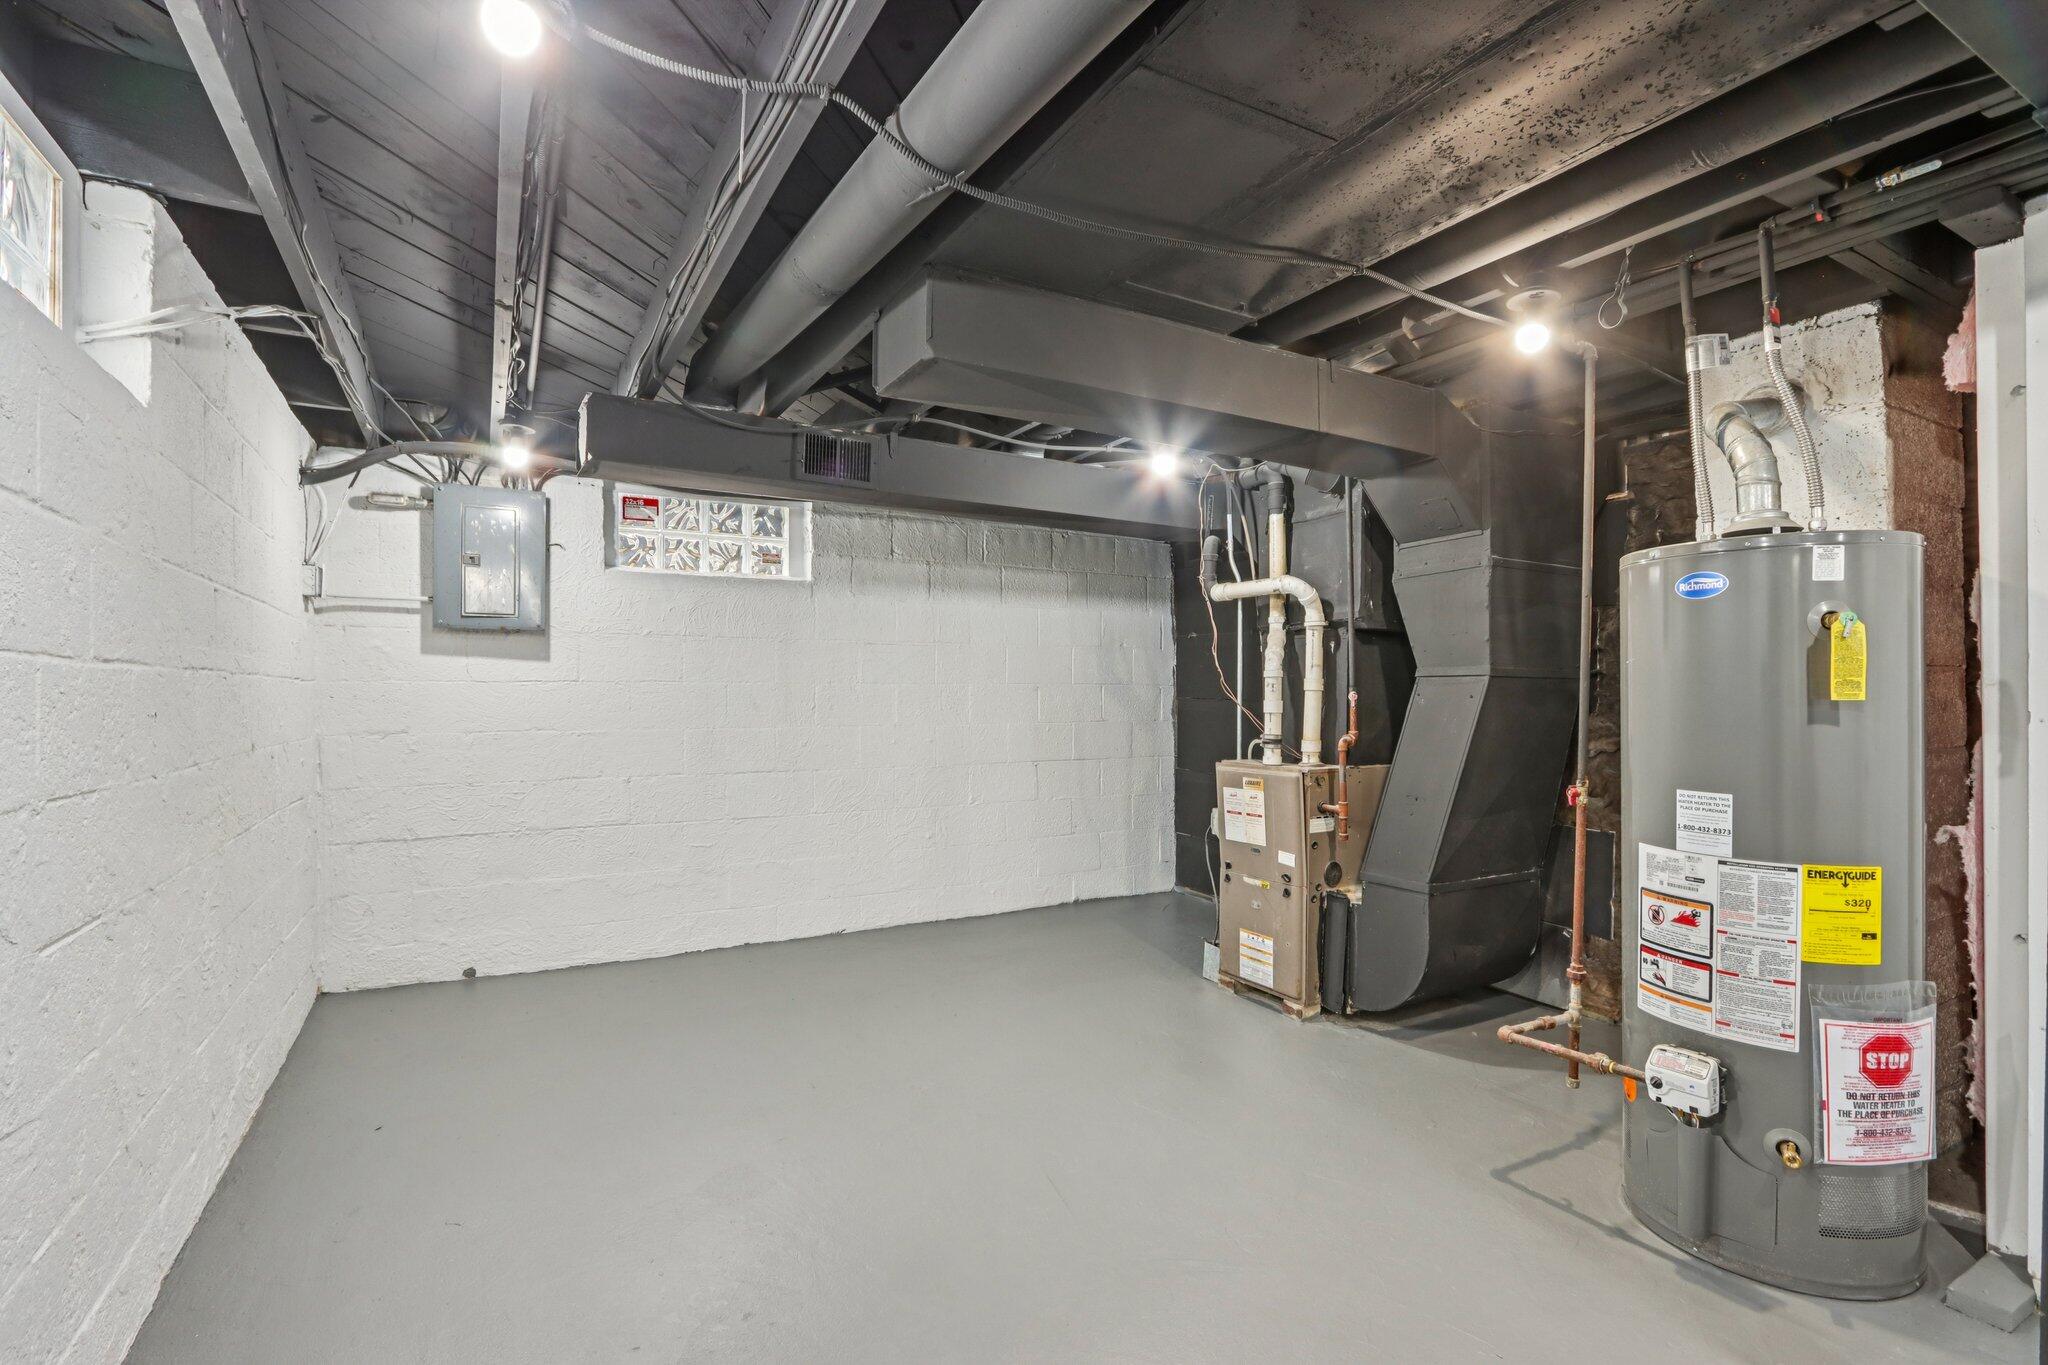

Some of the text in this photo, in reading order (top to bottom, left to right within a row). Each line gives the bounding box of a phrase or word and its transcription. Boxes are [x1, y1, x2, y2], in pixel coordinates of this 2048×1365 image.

[625, 498, 644, 506] 32x16
[1679, 578, 1724, 592] Richmond
[1678, 823, 1731, 836] 1-800-432-8373
[1807, 869, 1877, 881] ENERGYGUIDE
[1866, 1051, 1909, 1069] STOP
[1846, 1089, 1920, 1100] DO NOT RETURN THIS
[1853, 1099, 1915, 1109] WATER HEATER TO
[1837, 1107, 1923, 1119] THE PLACE OF PURCHASE
